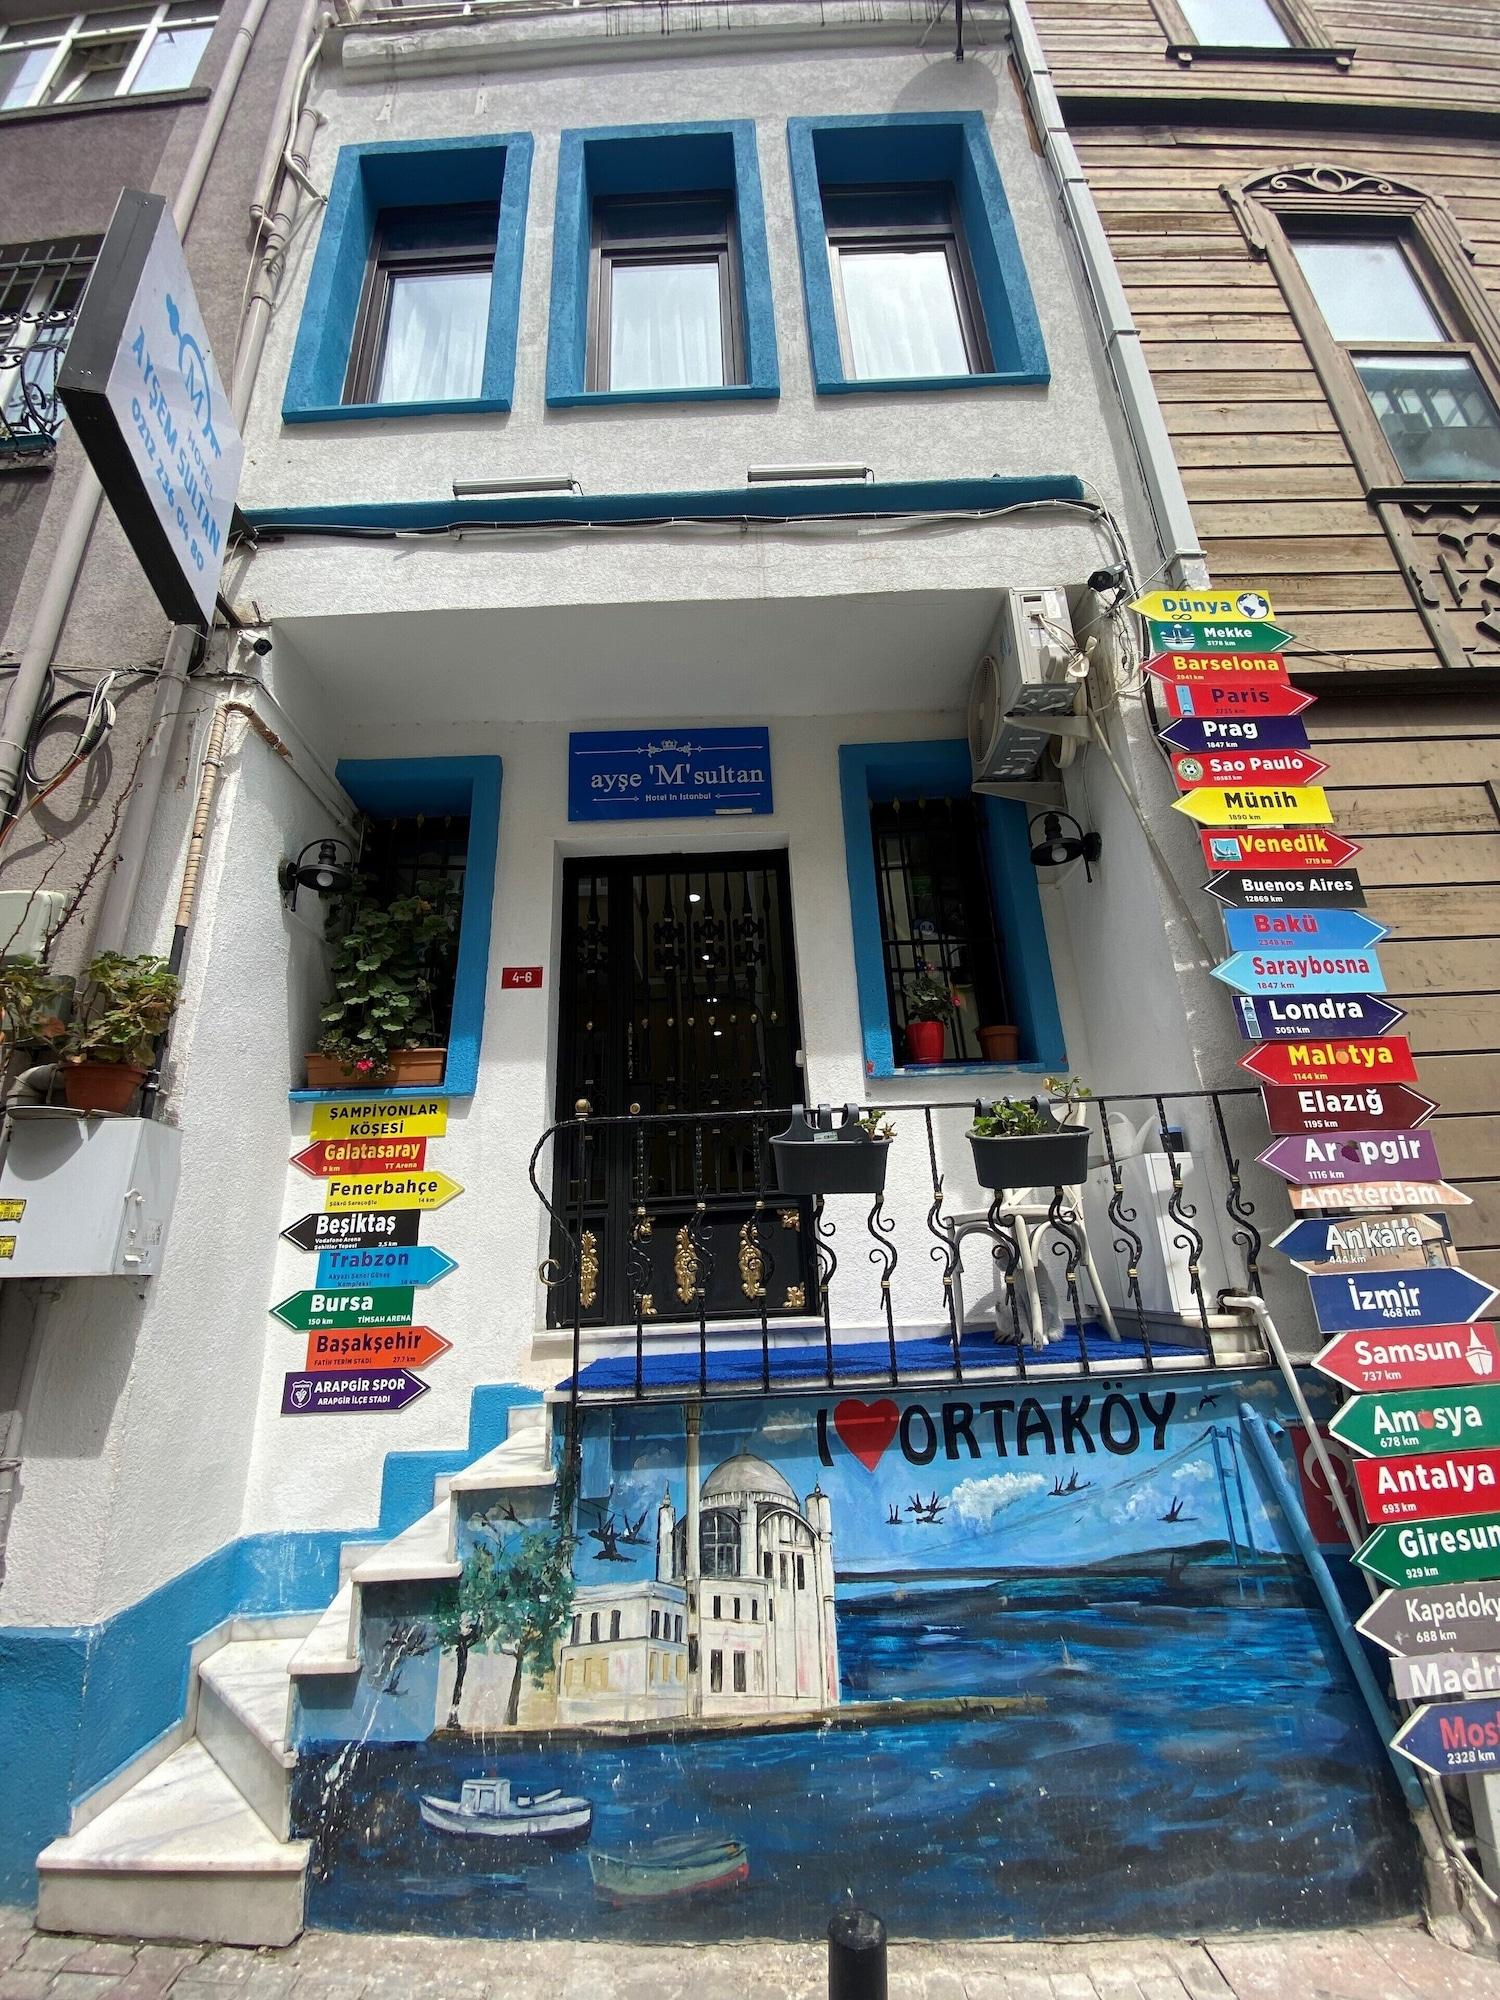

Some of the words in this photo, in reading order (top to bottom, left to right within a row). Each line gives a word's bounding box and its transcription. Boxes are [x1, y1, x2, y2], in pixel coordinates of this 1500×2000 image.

[132, 325, 177, 456] AYŞEM
[177, 447, 220, 557] SULTAN
[187, 426, 214, 503] HOTEL
[132, 397, 156, 461] 0212
[156, 458, 174, 508] 236
[177, 506, 188, 541] 04
[190, 539, 204, 571] 80
[1162, 598, 1232, 614] Dünya
[1204, 627, 1253, 638] Mekke
[1173, 655, 1280, 671] Barselona
[1211, 688, 1270, 703] Paris
[1202, 720, 1258, 739] Prag
[1209, 758, 1246, 772] Sao
[1249, 755, 1304, 771] Paulo
[591, 773, 642, 792] ayşe
[694, 765, 765, 785] sultan
[645, 794, 667, 802] Hotel
[1224, 791, 1298, 808] Münih
[1238, 834, 1329, 852] Venedik
[1241, 878, 1305, 892] Buenos
[1309, 878, 1354, 891] Aires
[1245, 895, 1269, 903] 12869
[1270, 895, 1284, 903] km
[1253, 914, 1318, 932] Bakü
[1252, 955, 1370, 978] Saraybosna
[512, 971, 532, 983] 4-6
[1268, 998, 1364, 1020] Londra
[1275, 1025, 1296, 1034] 3051
[1297, 1025, 1311, 1034] km
[1288, 1043, 1394, 1068] Maltya
[1293, 1072, 1313, 1080] 1144
[1314, 1072, 1328, 1080] km
[1298, 1088, 1384, 1116] Elazığ
[329, 1104, 438, 1120] ŞAMPİYONLAR
[350, 1120, 404, 1136] KÖŞESİ
[1303, 1119, 1324, 1129] 1195
[1325, 1119, 1338, 1128] km
[324, 1142, 421, 1161] Galatasaray
[1304, 1135, 1422, 1166] Arpgir
[1308, 1170, 1328, 1180] 1116
[1329, 1170, 1345, 1179] km
[329, 1179, 438, 1196] Fenerbahçe
[1300, 1182, 1442, 1208] Amsterdam
[316, 1213, 396, 1237] Beşiktaş
[1326, 1220, 1423, 1250] Ankara
[330, 1251, 409, 1268] Trabzon
[1329, 1255, 1349, 1264] 444
[1350, 1255, 1367, 1263] km
[1347, 1277, 1420, 1310] İzmir
[310, 1294, 374, 1313] Bursa
[357, 1316, 386, 1324] TİMSAH
[386, 1314, 411, 1322] ARENA
[1382, 1307, 1402, 1318] 468
[1405, 1307, 1422, 1317] km
[316, 1331, 421, 1355] Başakşehir
[1354, 1340, 1462, 1365] Samsun
[1362, 1371, 1382, 1381] 737
[1384, 1370, 1401, 1380] km
[314, 1377, 369, 1394] ARAPGİR
[372, 1379, 405, 1391] SPOR
[317, 1396, 351, 1406] ARAPGİR
[351, 1396, 368, 1405] İLÇE
[369, 1395, 391, 1403] STADI
[816, 1408, 834, 1467] I
[900, 1381, 1176, 1466] ORTAKÖY
[1373, 1404, 1483, 1437] Amsya
[1380, 1436, 1401, 1448] 678
[1402, 1435, 1419, 1446] km
[1378, 1460, 1495, 1494] Antalya
[1381, 1503, 1400, 1514] 693
[1402, 1502, 1417, 1512] km
[1398, 1525, 1500, 1558] Giresun
[1405, 1567, 1423, 1579] 929
[1424, 1566, 1439, 1577] km
[1416, 1631, 1437, 1643] 688
[1439, 1629, 1457, 1641] km
[1447, 1753, 1476, 1765] 2328
[1478, 1750, 1496, 1762] km
